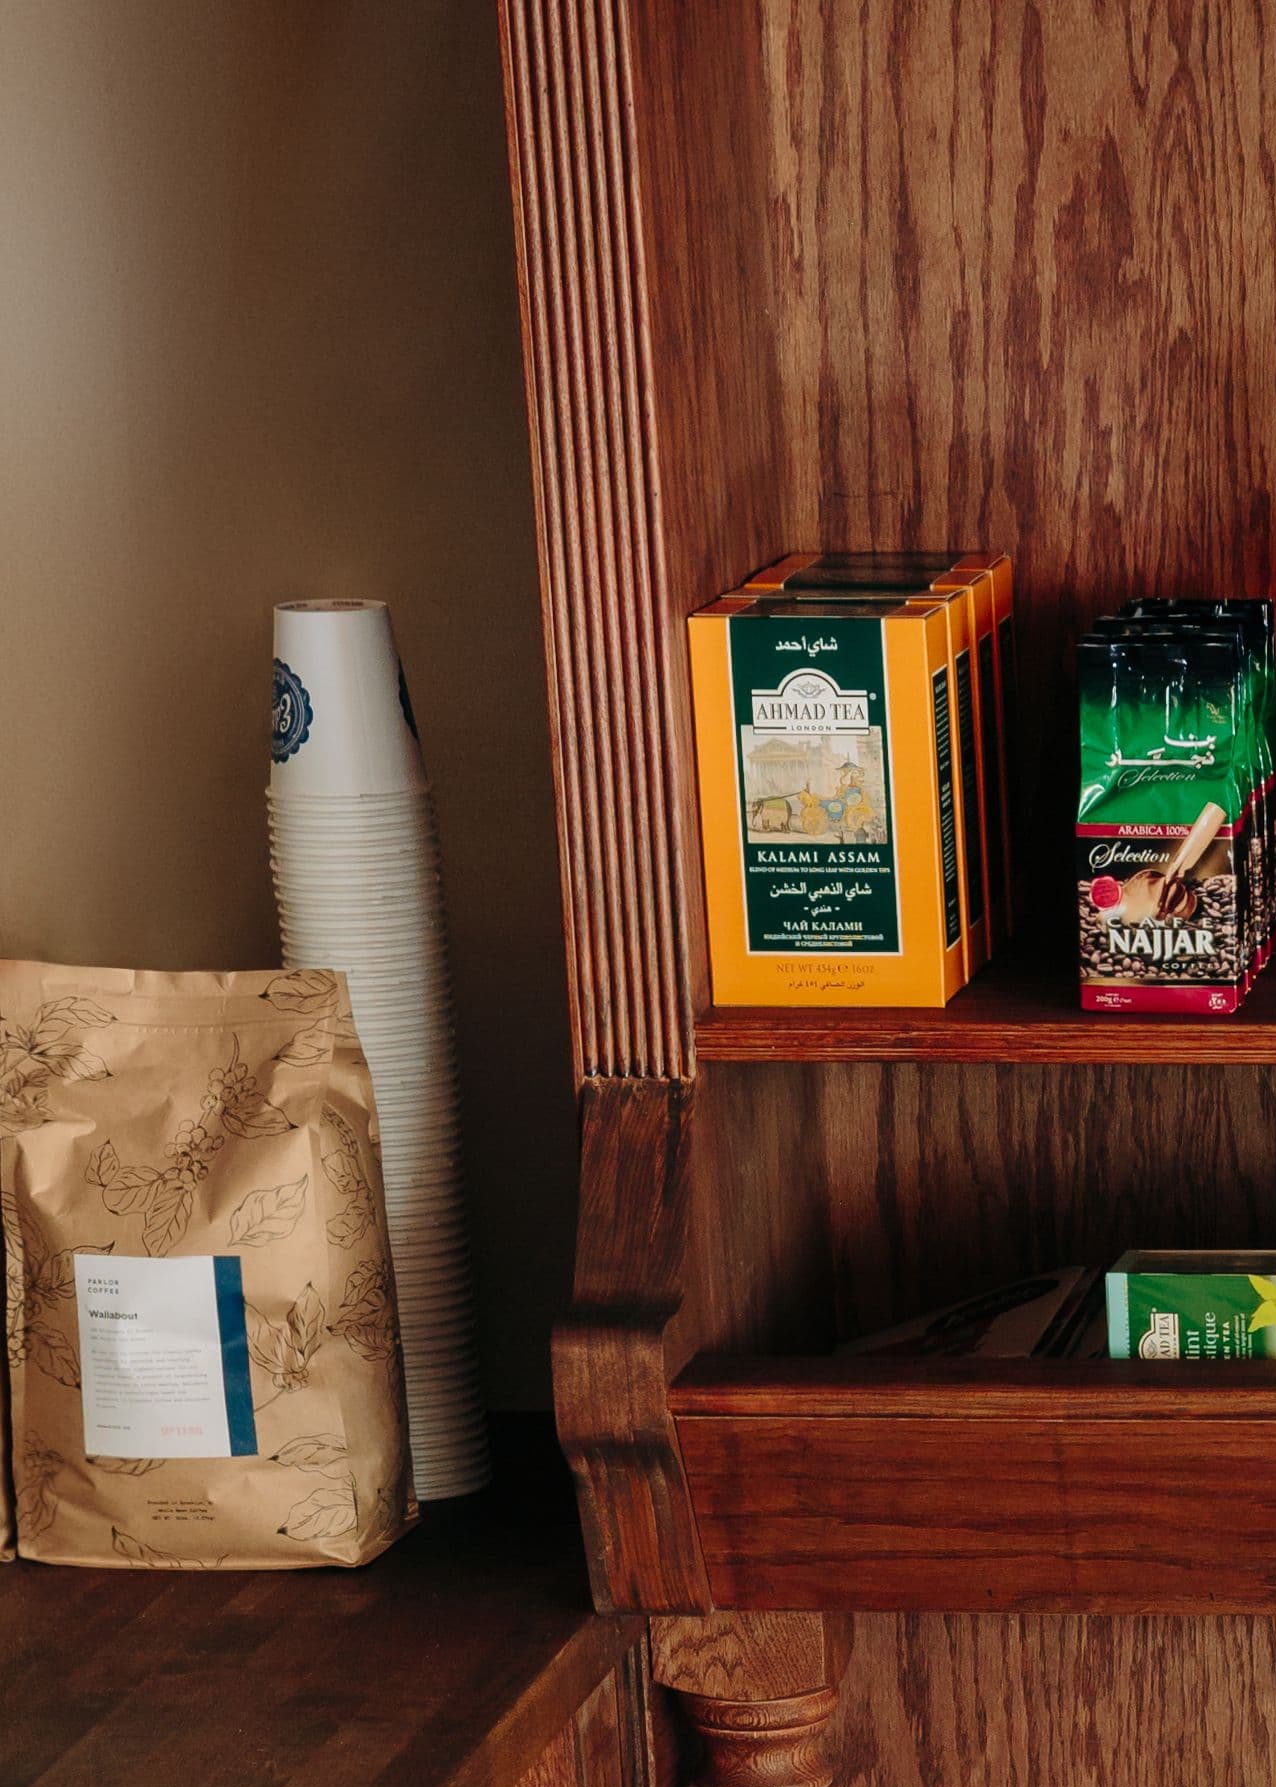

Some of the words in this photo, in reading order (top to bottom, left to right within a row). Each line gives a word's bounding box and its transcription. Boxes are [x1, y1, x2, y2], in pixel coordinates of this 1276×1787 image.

[775, 636, 807, 651] أحمد
[807, 636, 838, 657] شاي
[757, 703, 826, 720] AHMAD
[830, 703, 865, 720] TEA
[1118, 767, 1195, 789] Selection
[1118, 826, 1163, 835] ARABICA
[1166, 826, 1190, 835] 100%
[757, 851, 818, 863] KALAMI
[827, 851, 881, 863] ASSAM
[1088, 841, 1171, 873] Selection
[770, 882, 807, 898] الخشن
[807, 882, 843, 902] الذهبي
[844, 882, 872, 901] شاي
[811, 904, 832, 917] هندي
[784, 921, 809, 931] ЧАЙ
[812, 921, 863, 931] КАЛАМИ
[1106, 916, 1214, 929] CAFE
[1108, 928, 1217, 961] NAJJAR
[87, 1287, 120, 1295] COFFEE
[88, 1310, 138, 1321] Wallabout
[1223, 1321, 1231, 1342] TEA
